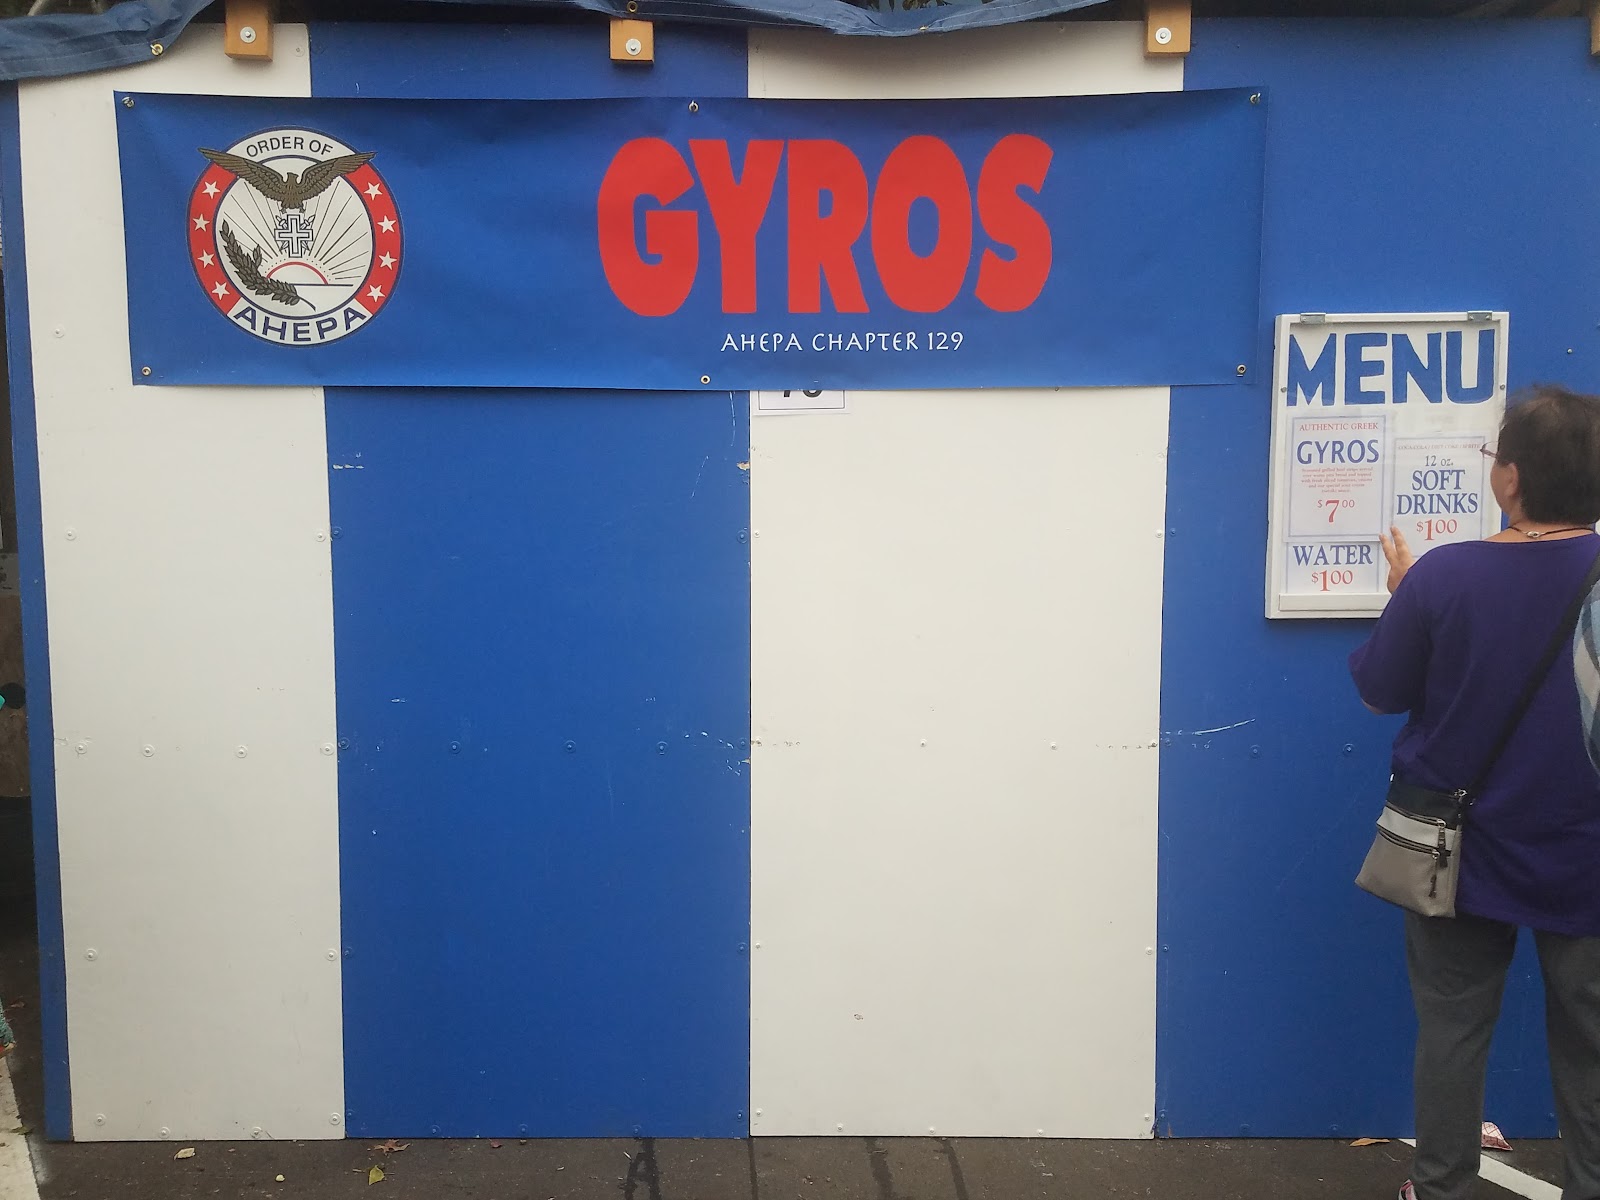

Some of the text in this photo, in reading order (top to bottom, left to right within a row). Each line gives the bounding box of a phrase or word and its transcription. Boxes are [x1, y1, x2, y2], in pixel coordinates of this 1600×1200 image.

[246, 136, 333, 157] ORDER OF
[597, 134, 1054, 317] GYROS
[233, 306, 367, 342] AHEPA
[720, 331, 964, 352] AHEPA CHAPTER 129
[1286, 329, 1495, 407] MENU
[1299, 422, 1378, 431] AUTHENTIC GREEK
[1296, 439, 1379, 464] GYROS
[1425, 455, 1437, 466] 12
[1412, 469, 1465, 491] SOFT
[1396, 492, 1478, 515] DRINKS
[1292, 544, 1373, 566] WATER
